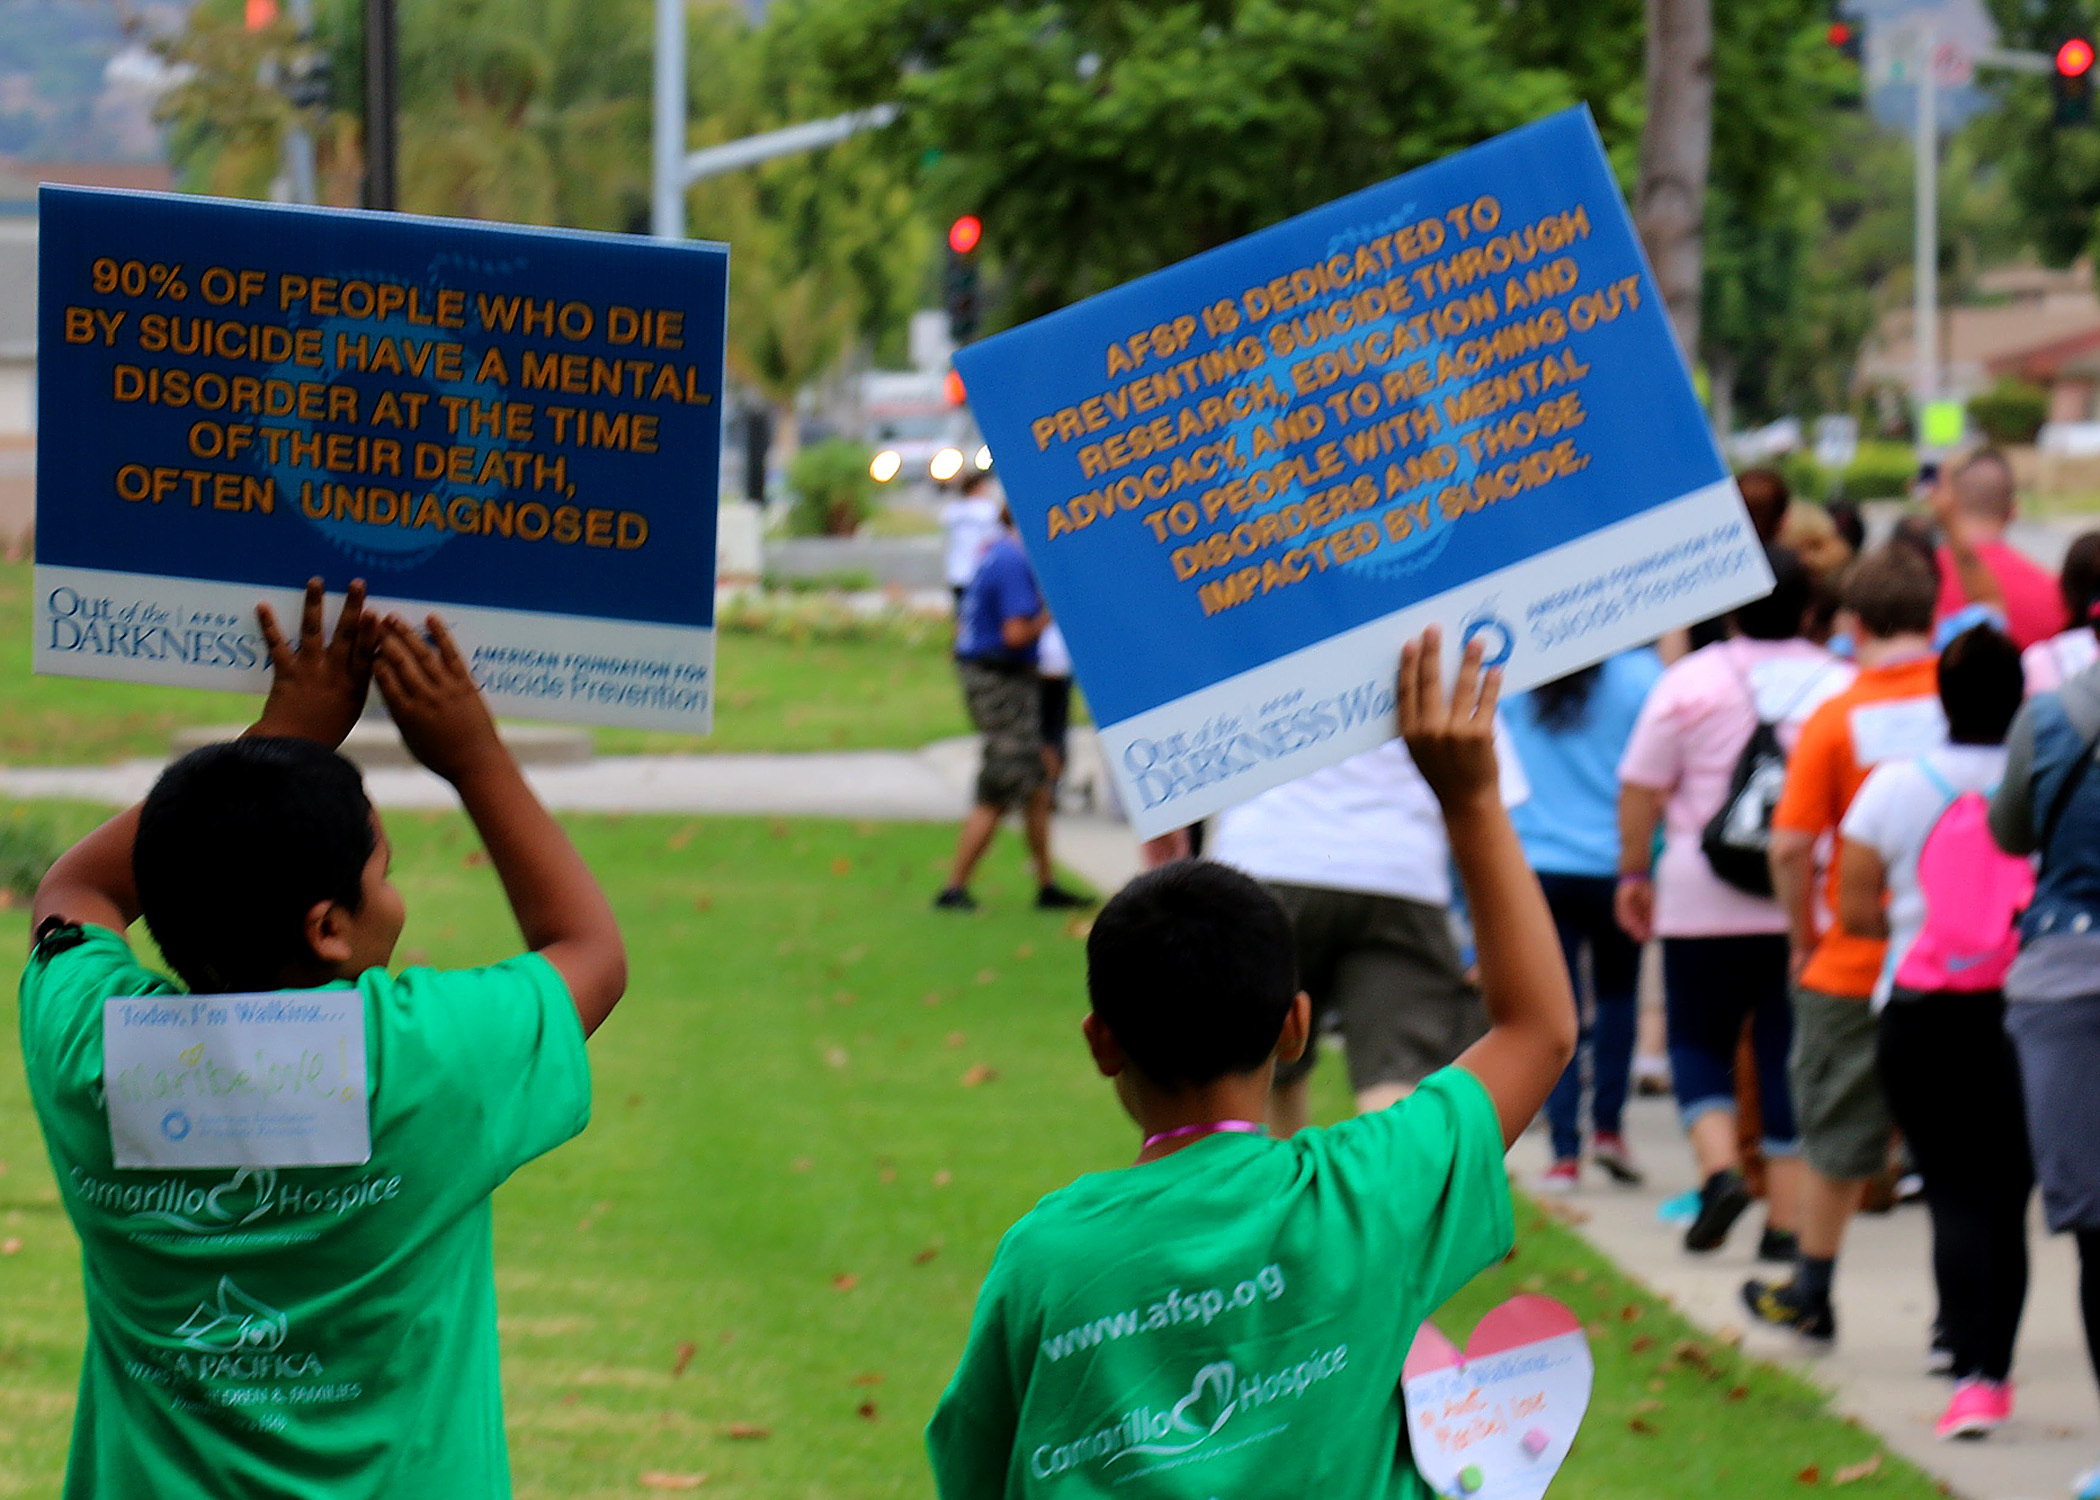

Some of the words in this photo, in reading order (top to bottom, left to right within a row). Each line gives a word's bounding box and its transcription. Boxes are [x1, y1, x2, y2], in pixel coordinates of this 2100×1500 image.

[92, 257, 190, 301] 90%
[200, 266, 267, 307] OF
[279, 274, 467, 328] PEOPLE
[476, 293, 595, 341] WHO
[606, 305, 685, 350] DIE
[1032, 336, 1266, 451] PREVENTING
[1268, 276, 1413, 356] SUICIDE
[1412, 205, 1590, 299] THROUGH
[1107, 315, 1197, 378] AFSP
[1202, 299, 1241, 338] IS
[1242, 219, 1445, 322] DEDICATED
[1447, 196, 1500, 239] TO
[1291, 288, 1498, 396] EDUCATION
[1505, 258, 1579, 314] AND
[64, 306, 127, 347] BY
[138, 313, 324, 367] SUICIDE
[336, 333, 464, 381] HAVE
[476, 346, 510, 386] A
[521, 350, 712, 405] MENTAL
[1253, 404, 1326, 459] AND
[1326, 383, 1381, 425] TO
[1382, 309, 1568, 405] REACHING
[1568, 276, 1639, 330] OUT
[113, 364, 359, 424] DISORDER
[371, 390, 431, 431] AT
[438, 395, 535, 441] THE
[545, 406, 660, 453] TIME
[188, 420, 255, 460] OF
[258, 427, 402, 477] THEIR
[414, 441, 576, 500] DEATH,
[1143, 501, 1199, 543] TO
[1201, 442, 1345, 522] PEOPLE
[1343, 404, 1441, 465] WITH
[1443, 349, 1590, 426] MENTAL
[115, 463, 275, 514] OFTEN
[301, 481, 649, 550] UNDIAGNOSED
[1171, 475, 1380, 581] DISORDERS
[1386, 445, 1458, 499] AND
[1460, 393, 1586, 463] THOSE
[48, 587, 113, 620] Out
[117, 600, 141, 624] of
[140, 603, 170, 625] the
[1198, 522, 1380, 617] IMPACTED
[1384, 497, 1430, 542] BY
[48, 616, 258, 668] DARKNESS
[571, 671, 710, 711] Prevention
[1132, 701, 1337, 811] DARKNESS
[277, 1174, 403, 1217] Hospice
[1031, 1405, 1172, 1480] Camarillo
[1238, 1343, 1349, 1413] Hospice
